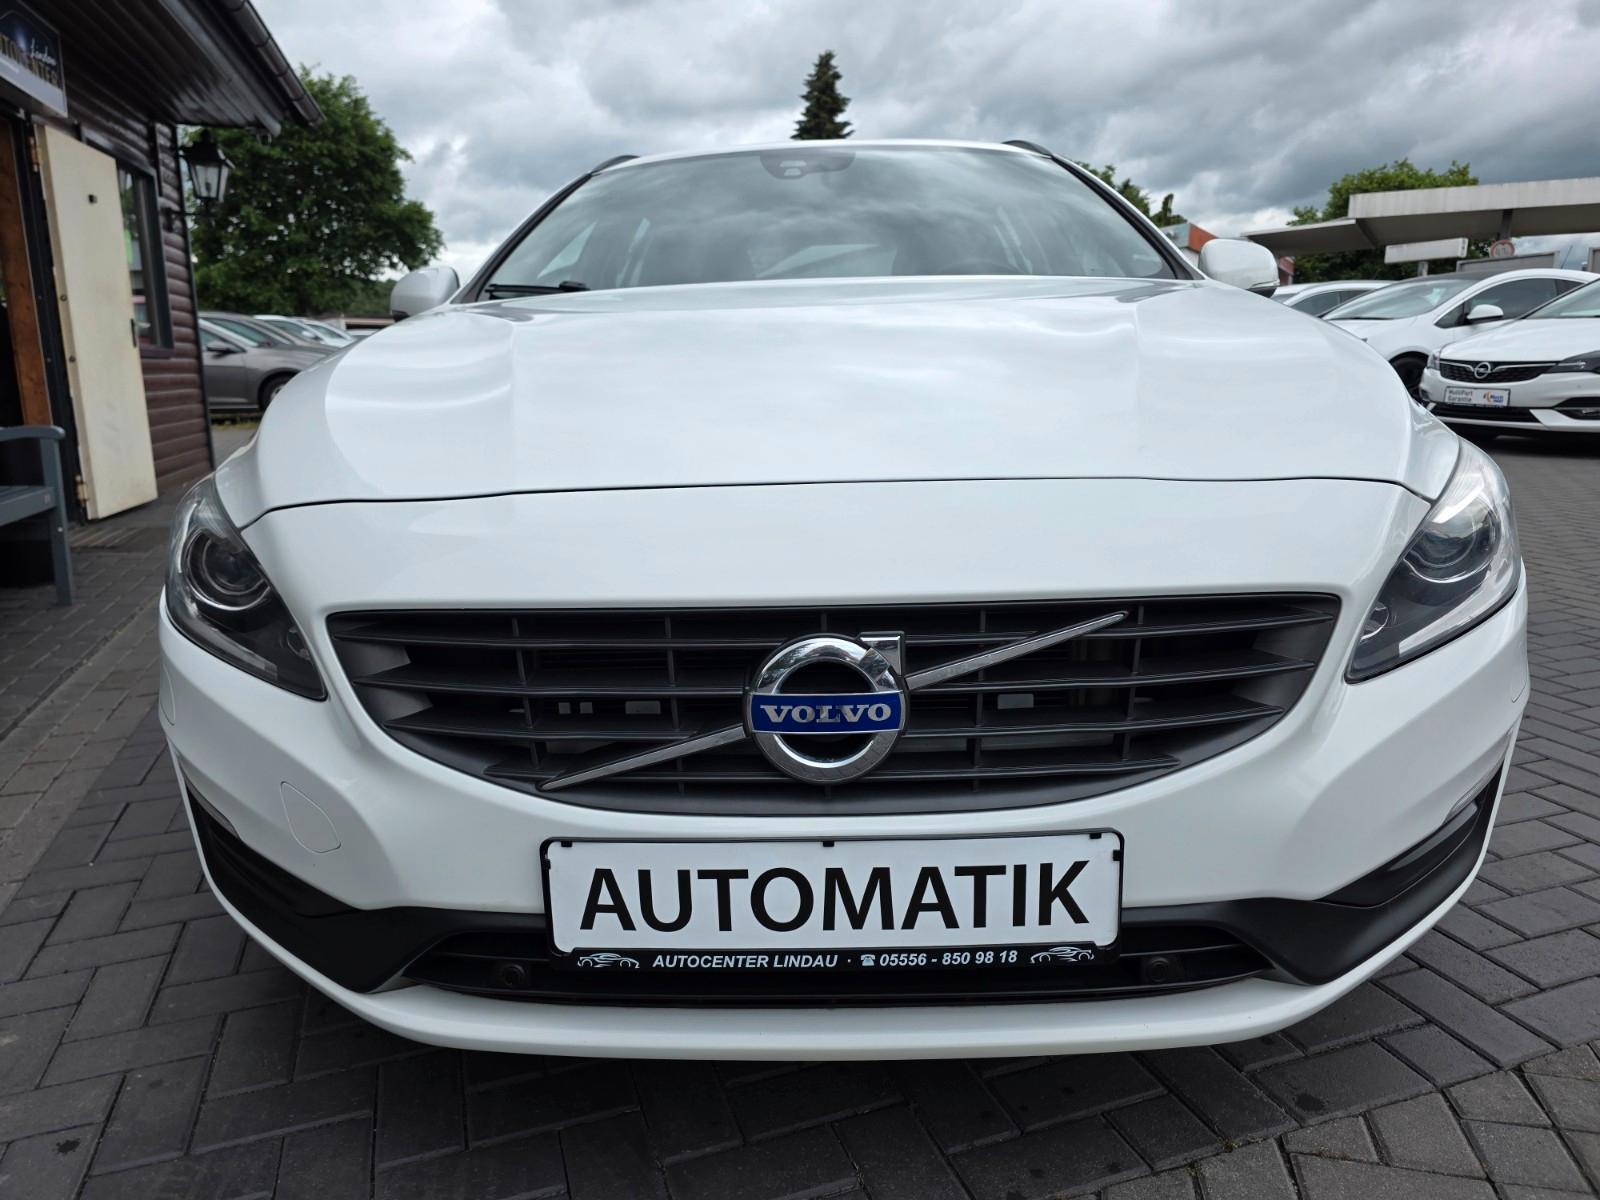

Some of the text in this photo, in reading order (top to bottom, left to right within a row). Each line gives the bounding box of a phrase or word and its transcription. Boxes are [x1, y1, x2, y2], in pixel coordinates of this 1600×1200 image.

[760, 703, 892, 724] VOLVO
[579, 860, 1091, 933] AUTOMATIK
[652, 955, 769, 968] AUTOCENTER
[773, 954, 838, 967] LINDAU
[879, 953, 927, 966] 05556
[941, 952, 971, 965] 850
[975, 951, 995, 963] 98
[1000, 950, 1018, 963] 18
